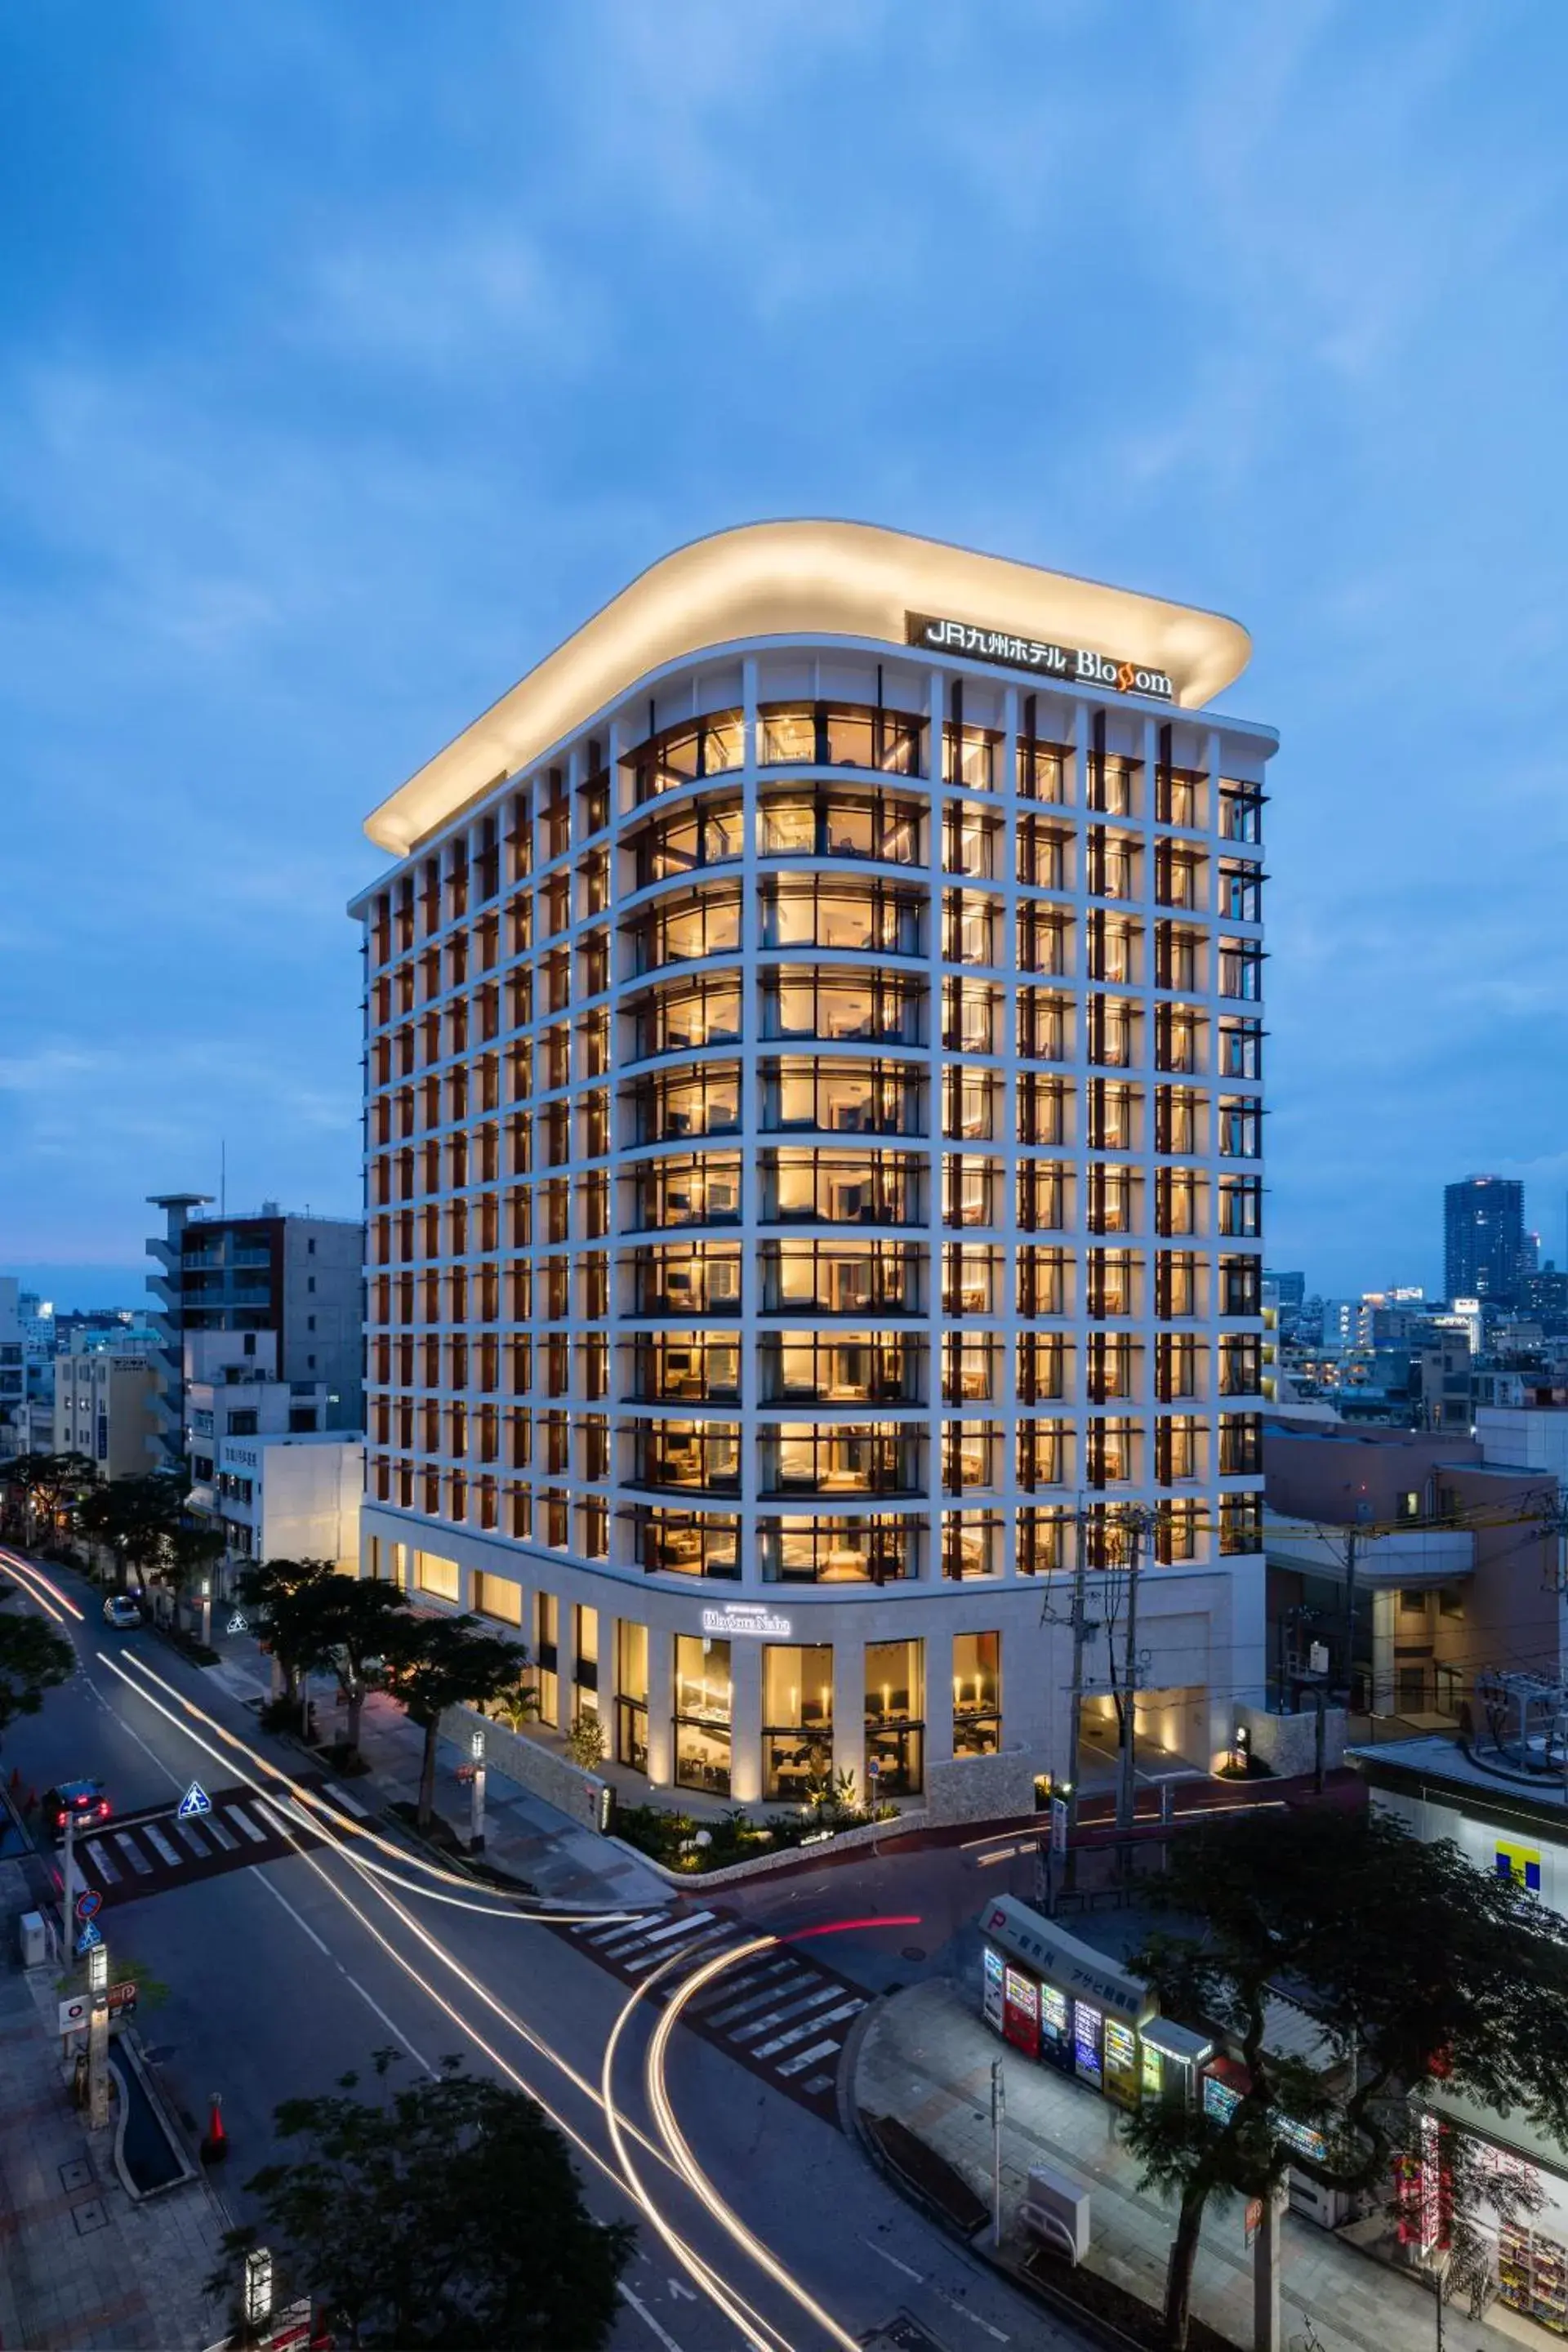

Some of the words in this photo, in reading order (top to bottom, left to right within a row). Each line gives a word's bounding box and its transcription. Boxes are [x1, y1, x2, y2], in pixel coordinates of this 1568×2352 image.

[927, 621, 1065, 670] JR九州ホテル
[1076, 650, 1172, 693] Blossom
